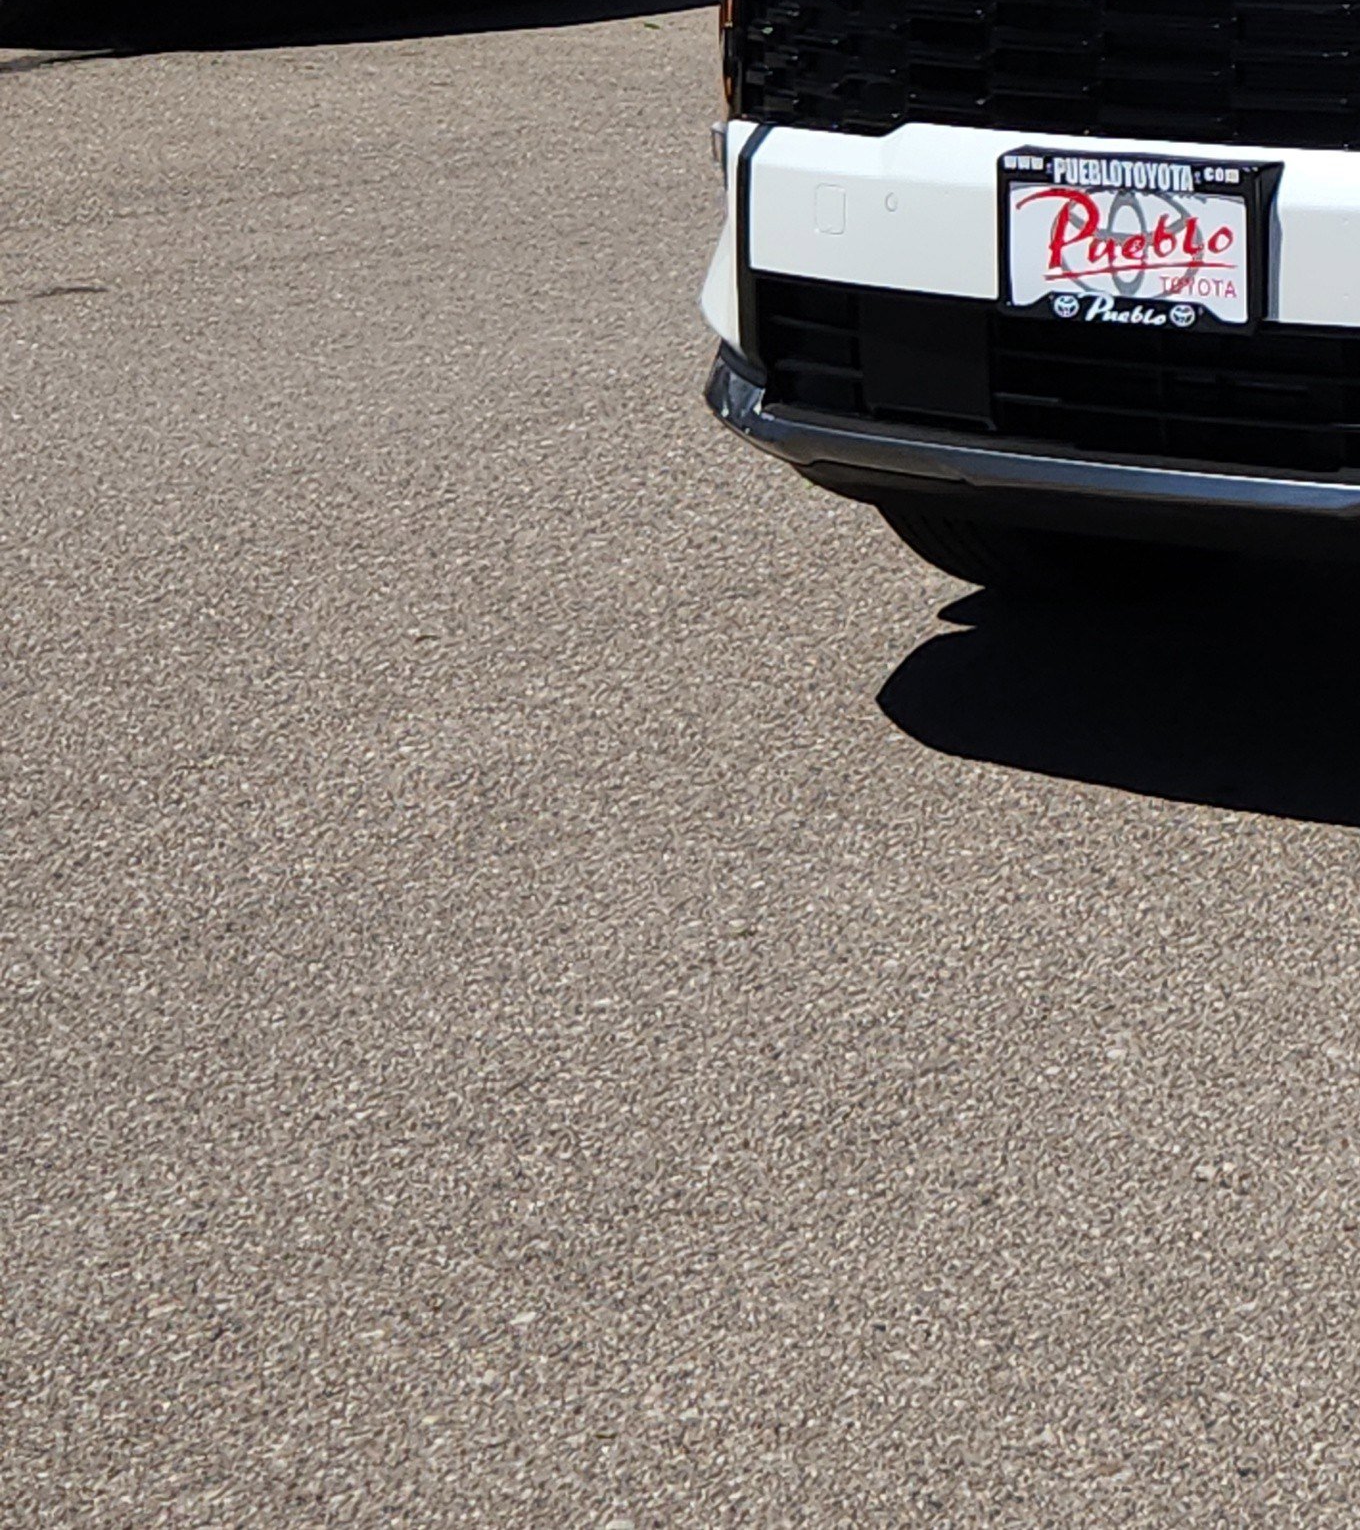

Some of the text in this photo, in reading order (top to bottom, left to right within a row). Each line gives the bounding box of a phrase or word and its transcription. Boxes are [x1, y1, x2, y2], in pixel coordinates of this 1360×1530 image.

[1016, 188, 1233, 270] Pueblo
[1160, 275, 1237, 298] TOYOTA
[1079, 292, 1167, 325] Pueblo
